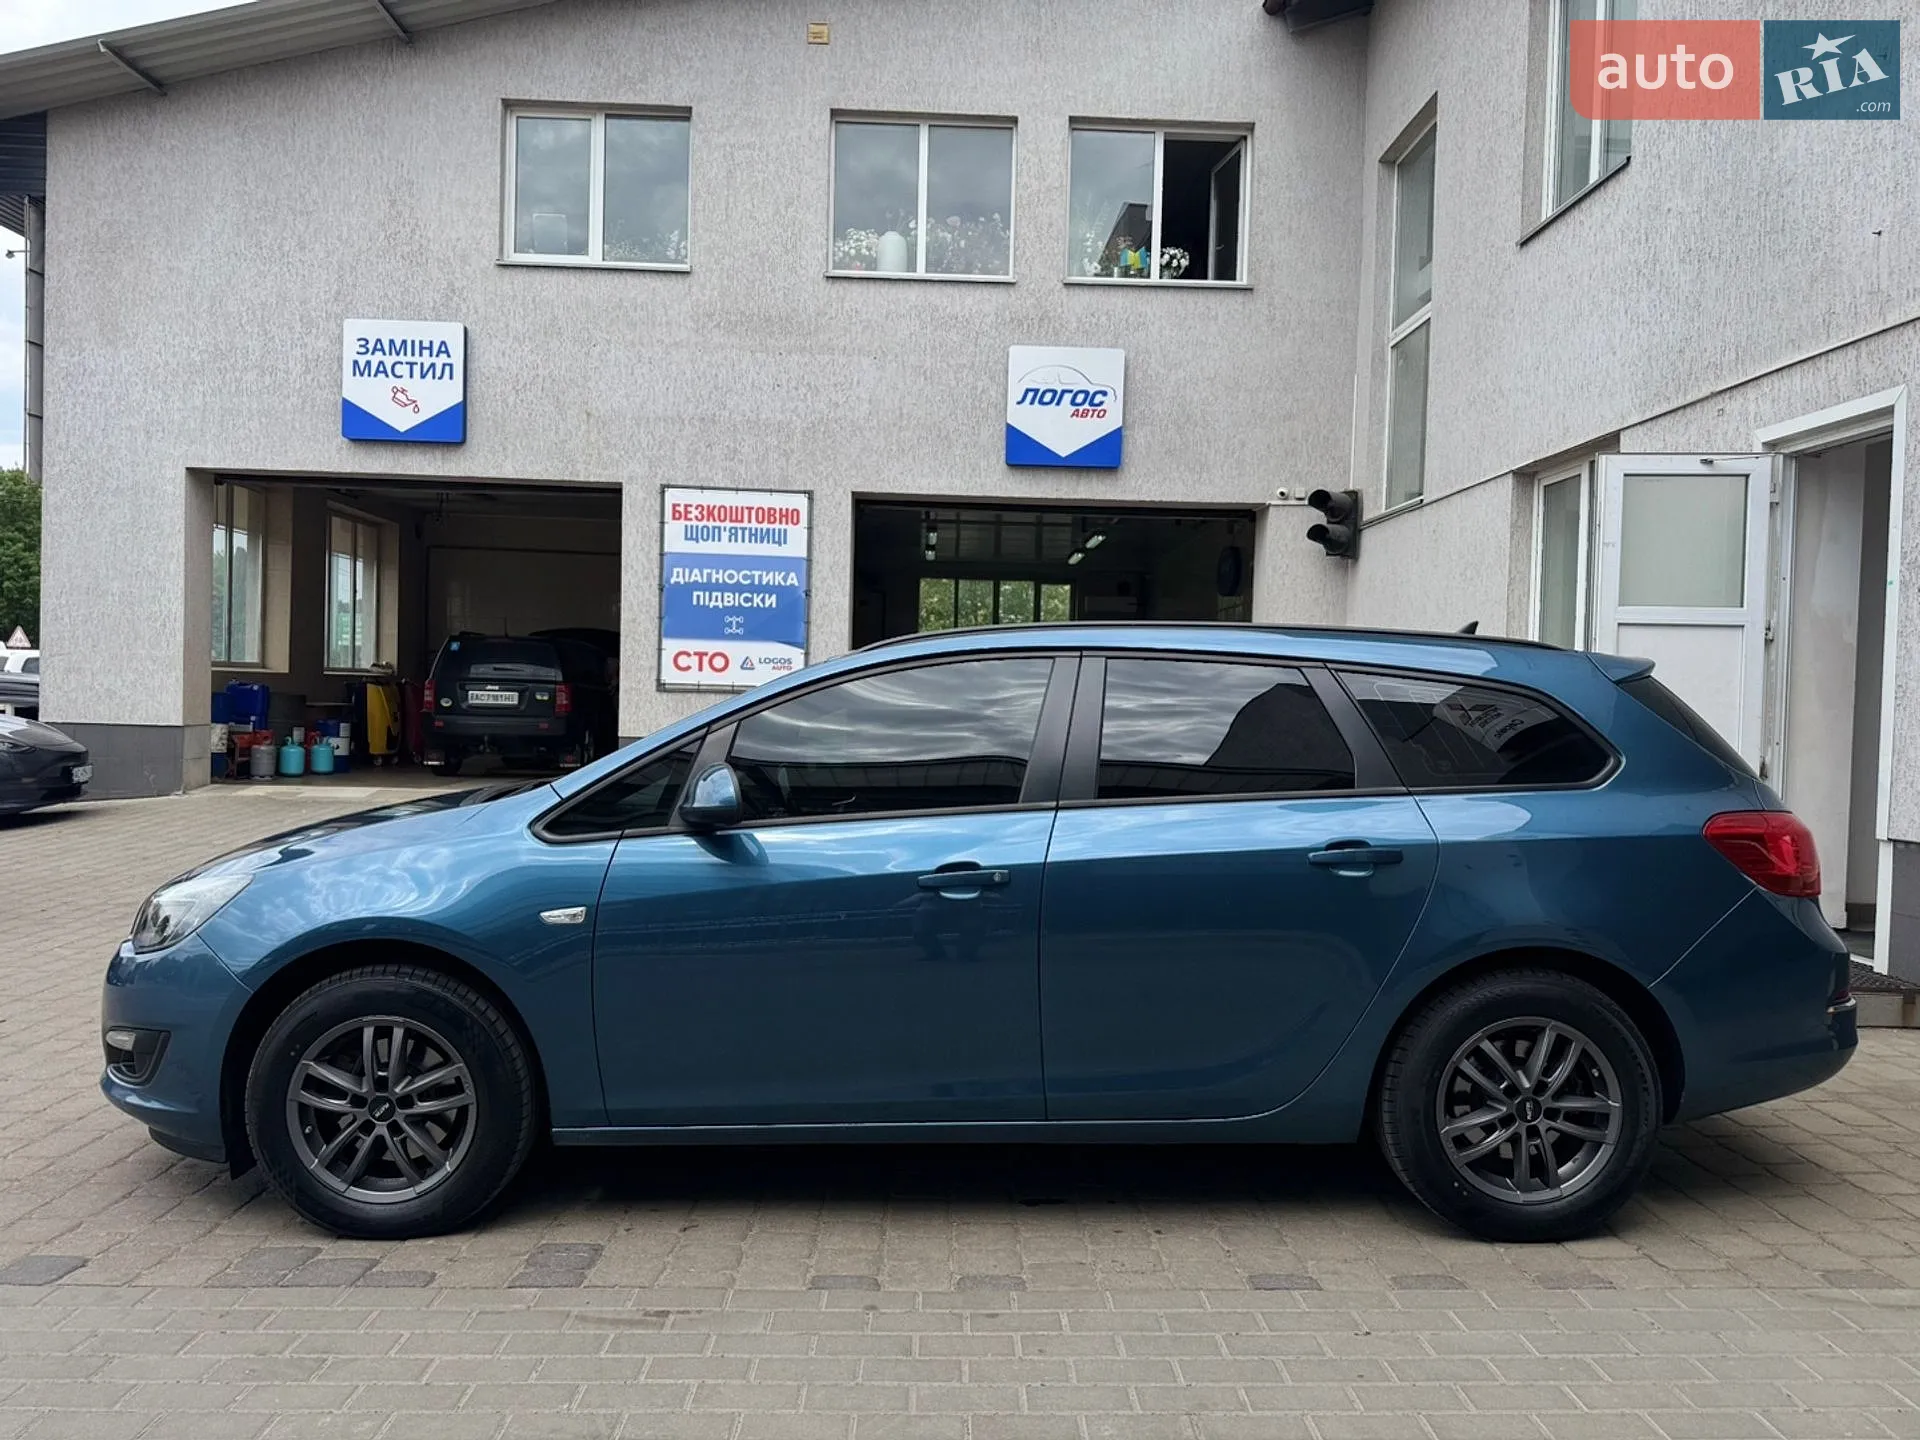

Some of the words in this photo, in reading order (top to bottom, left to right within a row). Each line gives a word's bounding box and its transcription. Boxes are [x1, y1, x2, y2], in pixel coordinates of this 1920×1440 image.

[355, 337, 451, 358] ЗАМІНА
[352, 359, 454, 381] МАСТИЛ
[1016, 388, 1108, 408] ЛОГОС
[1070, 408, 1107, 419] АВТО
[671, 503, 800, 526] БЕЗКОШТОВНО
[684, 524, 788, 547] ЩОП'ЯТНИЦІ
[670, 567, 799, 586] ДІАГНОСТИКА
[692, 591, 777, 609] ПІДВІСКИ
[672, 650, 730, 673] СТО
[758, 657, 793, 665] LOGOS
[771, 664, 793, 672] AUTO
